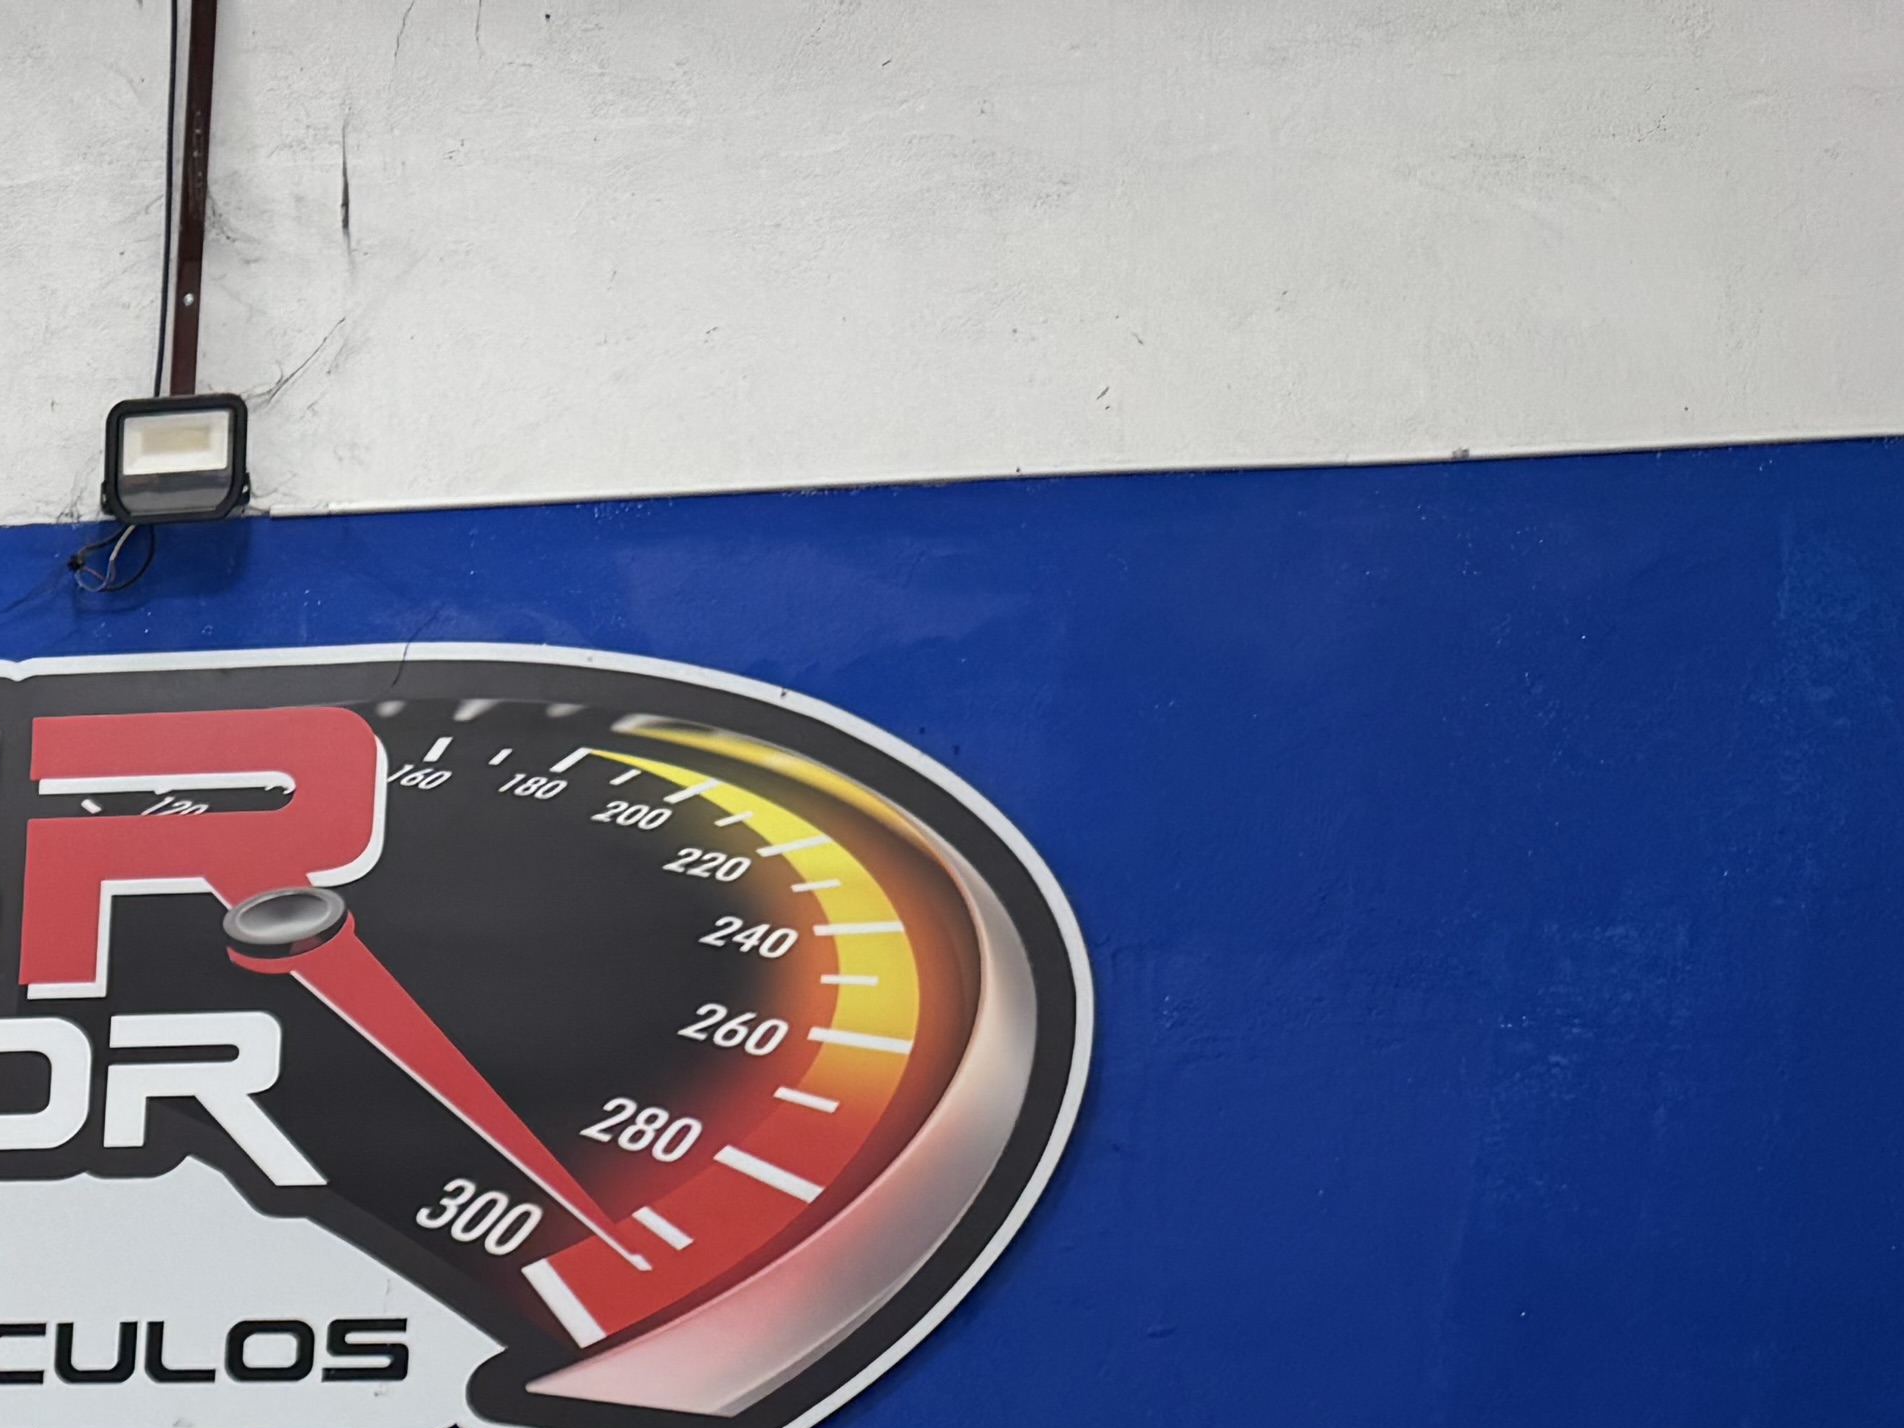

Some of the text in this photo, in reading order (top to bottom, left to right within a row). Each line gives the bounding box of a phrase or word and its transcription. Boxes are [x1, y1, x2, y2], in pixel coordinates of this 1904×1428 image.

[387, 763, 453, 791] 160
[497, 772, 568, 800] 180
[590, 800, 673, 830] 200
[662, 847, 752, 882] 220
[698, 915, 798, 959] 240
[677, 1002, 789, 1057] 260
[579, 1096, 703, 1163] 280
[415, 1178, 544, 1256] 300
